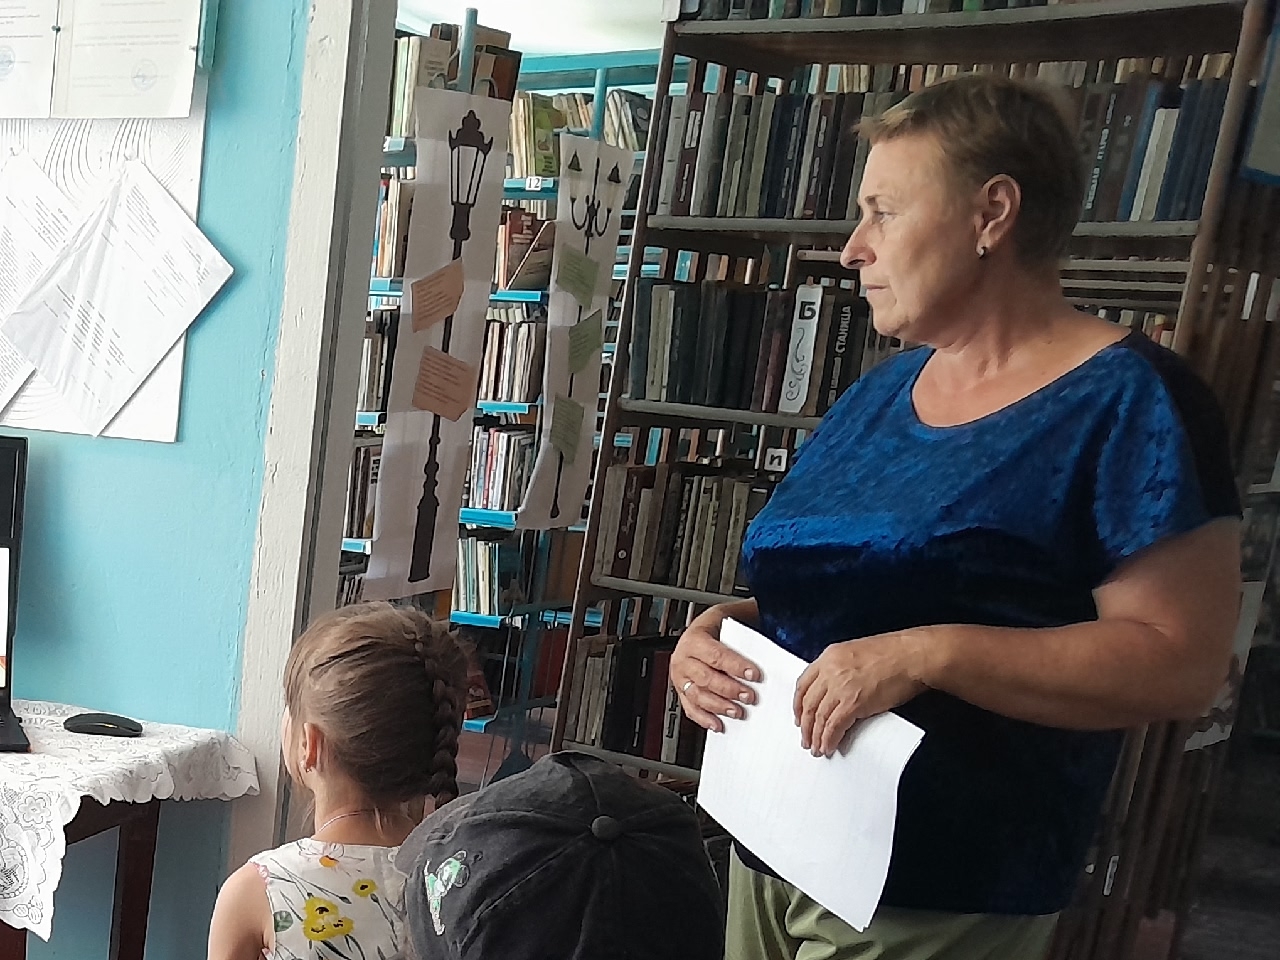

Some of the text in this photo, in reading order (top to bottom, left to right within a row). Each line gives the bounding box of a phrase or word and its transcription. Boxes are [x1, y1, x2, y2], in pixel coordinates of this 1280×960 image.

[528, 178, 541, 189] 12
[799, 300, 817, 320] Б
[835, 305, 852, 354] СТАНИЦА
